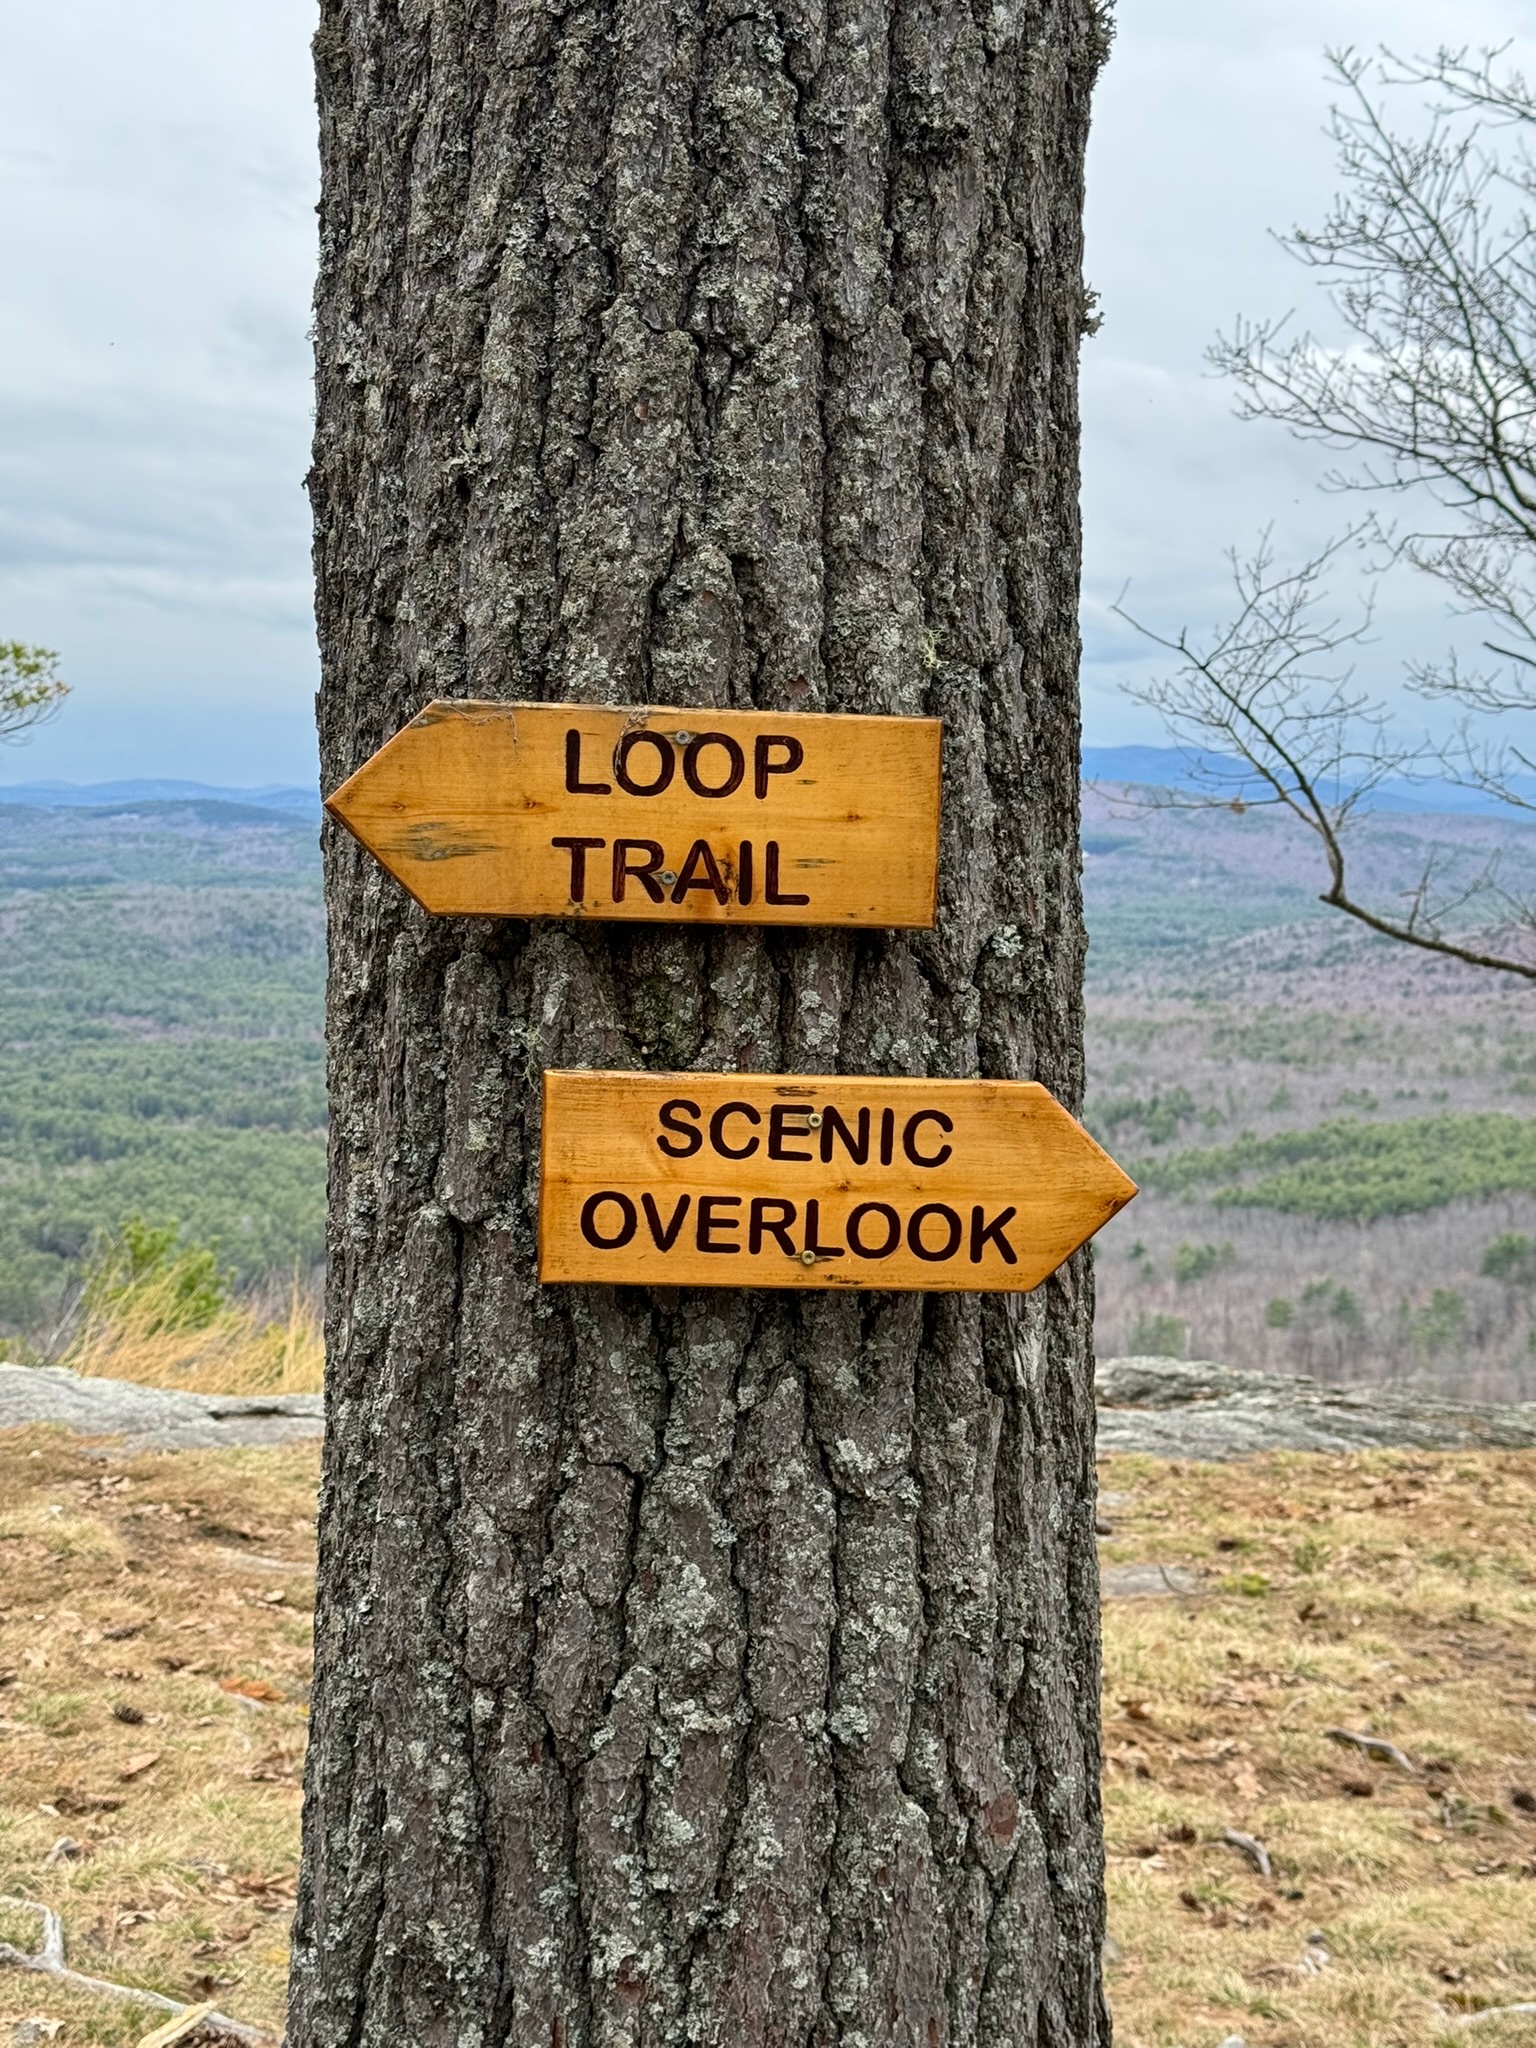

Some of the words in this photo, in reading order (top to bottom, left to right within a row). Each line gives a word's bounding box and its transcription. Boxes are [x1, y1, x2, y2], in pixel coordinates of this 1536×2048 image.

[565, 728, 804, 800] LOOP
[551, 836, 811, 907] TRAIL
[656, 1098, 955, 1168] SCENIC
[580, 1190, 1018, 1265] OVERLOOK
